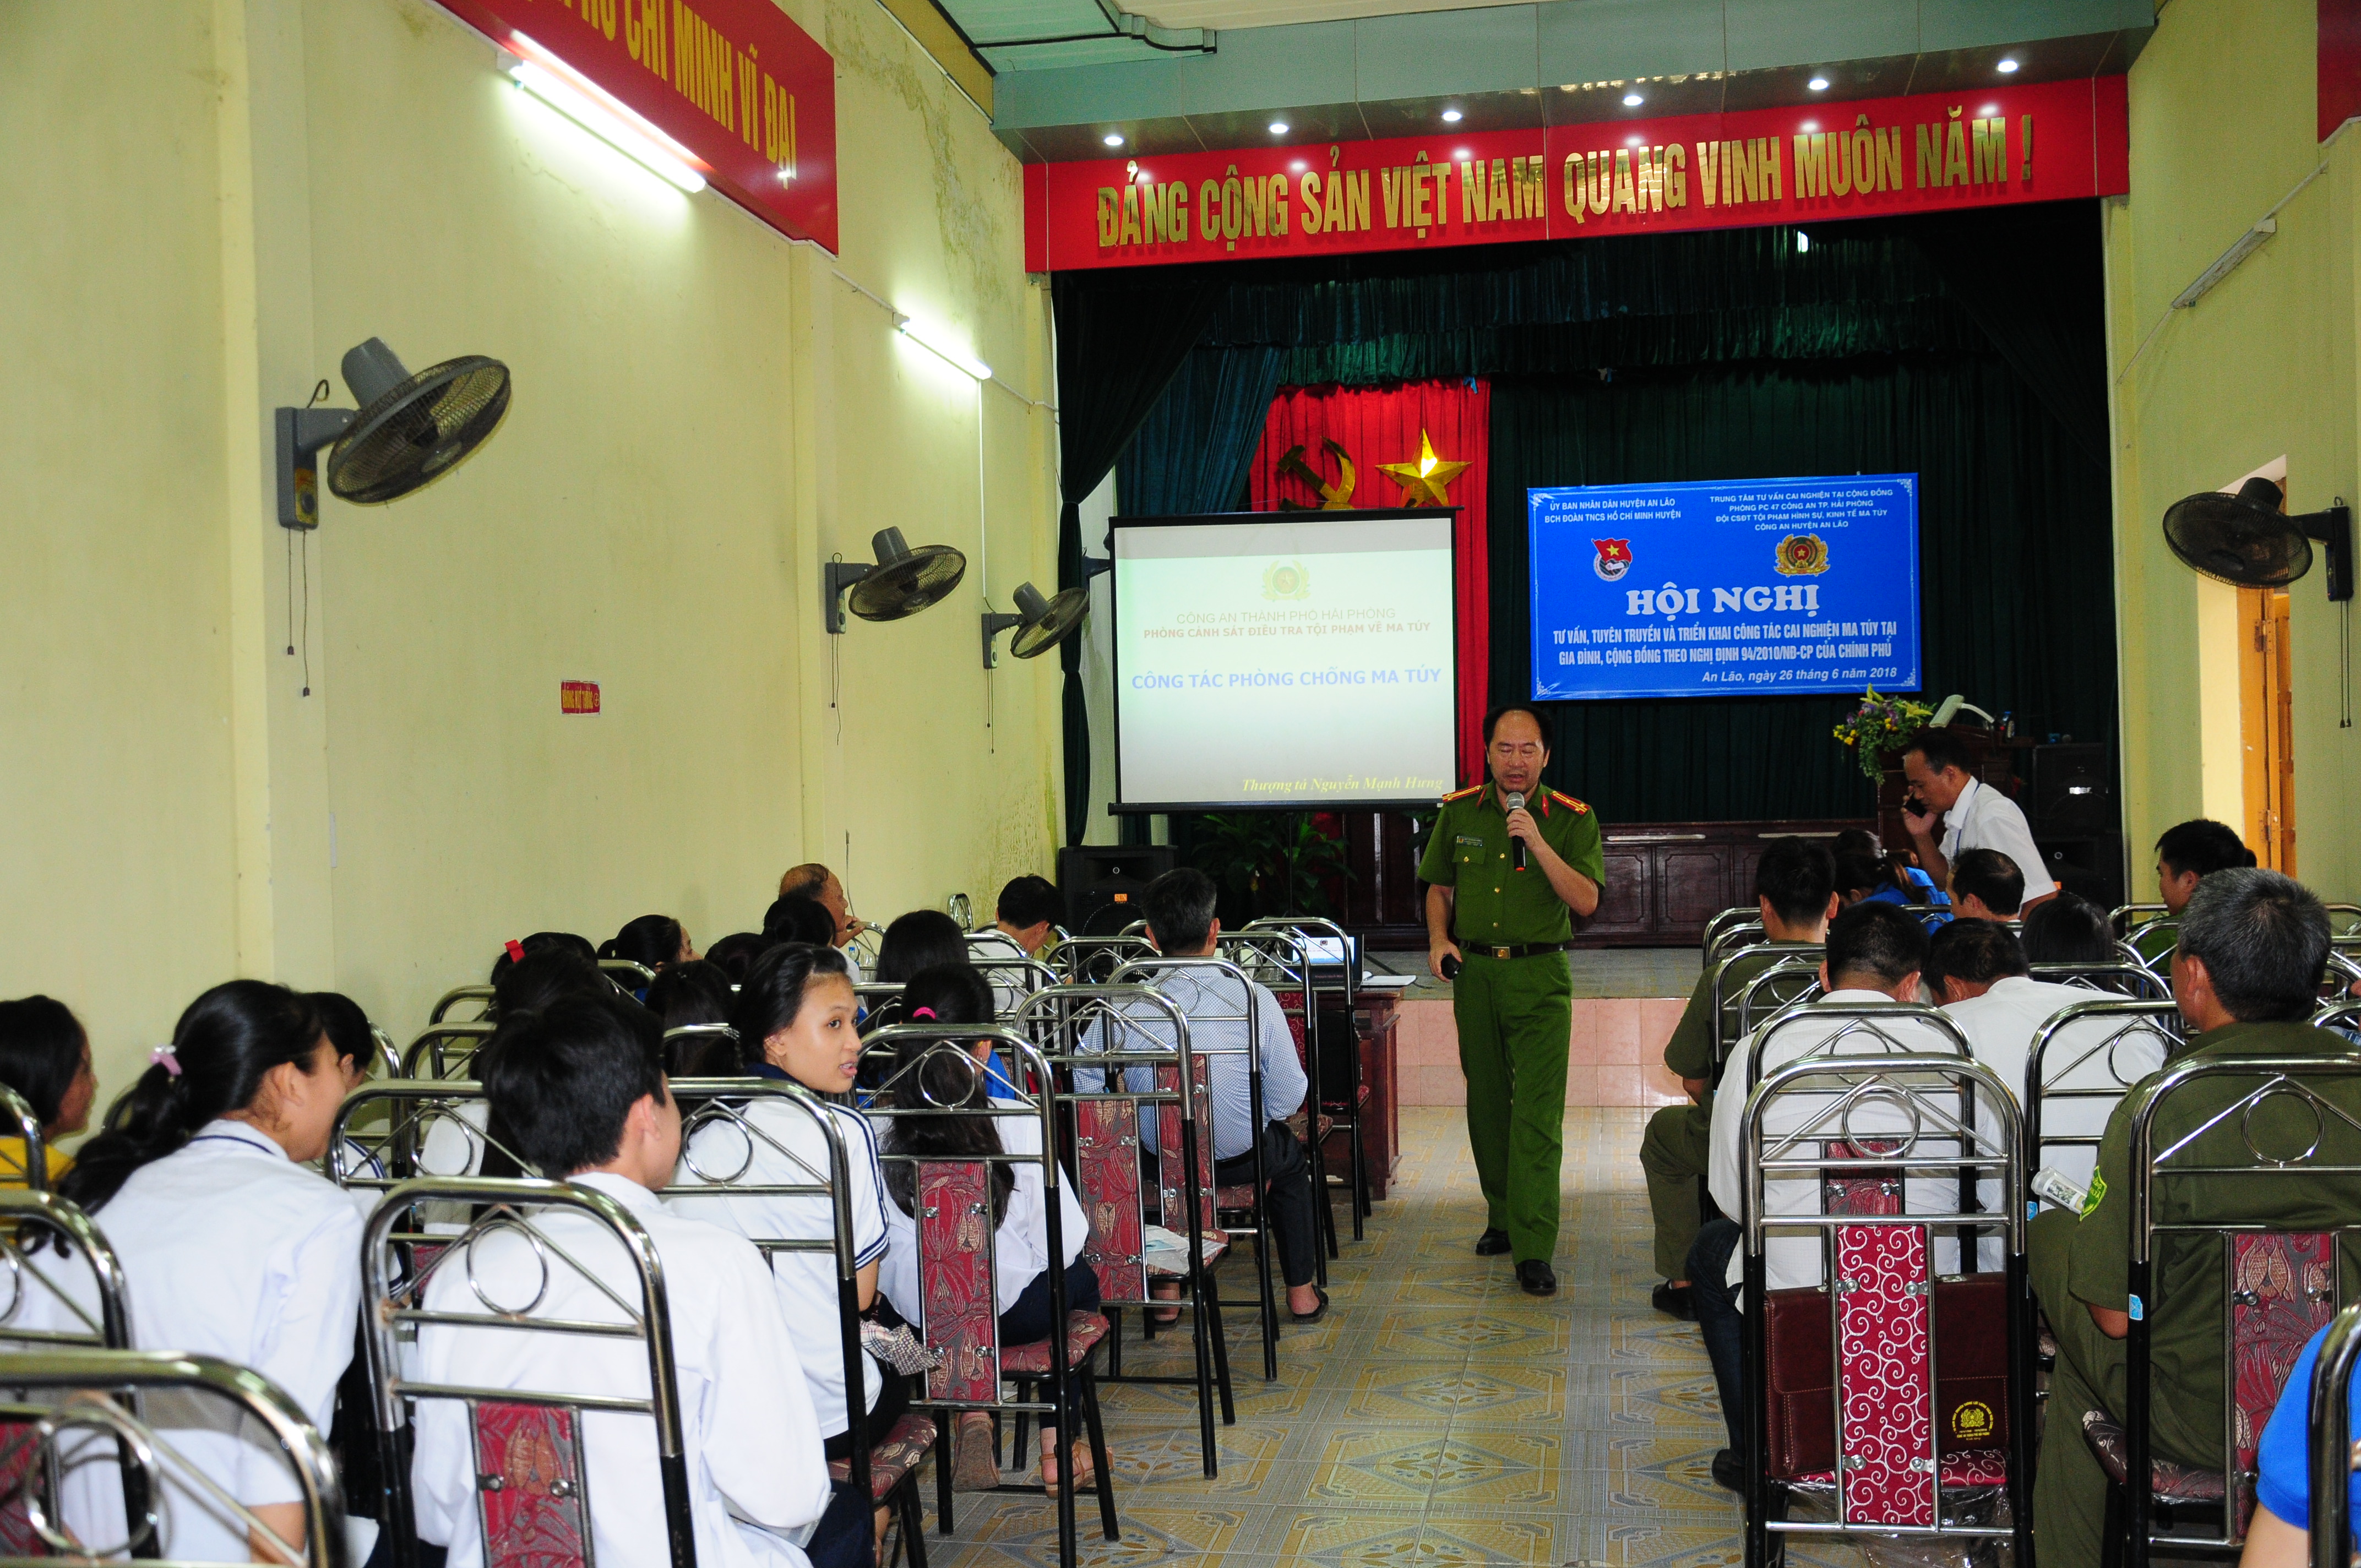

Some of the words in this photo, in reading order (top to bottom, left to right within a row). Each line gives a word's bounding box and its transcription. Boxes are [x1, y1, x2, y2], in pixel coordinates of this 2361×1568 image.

[673, 0, 733, 133] MINH
[764, 73, 797, 190] ĐẠI
[1097, 160, 1189, 248] ĐẢNG
[1200, 165, 1289, 251] CỘNG
[1301, 145, 1370, 235] SẢN
[1381, 150, 1451, 238] VIỆT
[1461, 155, 1545, 223] NAM
[1564, 143, 1686, 224] QUANG
[1696, 137, 1782, 209] VINH
[1792, 113, 1902, 200] MUÔN
[1916, 105, 2008, 190] NĂM
[1550, 500, 1560, 510] ỦY
[1562, 502, 1577, 510] BAN
[1580, 499, 1600, 510] NHÂN
[1602, 499, 1618, 509] DÂN
[1620, 498, 1645, 509] HUYỆN
[1660, 497, 1675, 507] LÃO
[1729, 504, 1756, 512] PHÒNG
[1781, 502, 1803, 510] CÔNG
[1831, 499, 1844, 508] HẢI
[1846, 499, 1874, 507] PHÒNG
[1544, 515, 1560, 523] BCH
[1563, 513, 1583, 522] ĐOÀN
[1585, 513, 1606, 521] TNCS
[1620, 510, 1633, 520] CHÍ
[1634, 511, 1653, 520] MINH
[1655, 509, 1681, 520] HUYỆN
[1755, 522, 1777, 531] CÔNG
[1792, 521, 1818, 529] HUYỆN
[1832, 520, 1849, 528] LÃO
[1626, 581, 1700, 621] HỘI
[1712, 585, 1820, 617] NGHỊ
[1177, 612, 1215, 624] CÔNG
[1219, 613, 1237, 623] AN
[1241, 610, 1286, 622] THÀNH
[1348, 606, 1395, 619] PHÒNG
[1144, 627, 1184, 639] PHÒNG
[1223, 624, 1244, 636] SÁT
[1280, 626, 1303, 635] TRA
[1306, 623, 1327, 636] TỘI
[1331, 624, 1364, 635] PHẠM
[1386, 623, 1403, 632] MA
[1407, 619, 1430, 631] TÚY
[1553, 629, 1566, 644] TƯ
[1568, 625, 1590, 645] VẤN,
[1592, 627, 1622, 644] TUYÊN
[1663, 625, 1676, 641] VÀ
[1678, 622, 1706, 641] TRIỂN
[1708, 625, 1731, 640] KHAI
[1734, 623, 1760, 640] CÔNG
[1762, 622, 1781, 639] TÁC
[1784, 624, 1800, 639] CAI
[1803, 620, 1839, 640] NGHIỆN
[1842, 623, 1858, 636] MA
[1860, 619, 1878, 636] TÚY
[1881, 622, 1897, 639] TẠI
[1559, 651, 1575, 665] GIA
[1577, 648, 1603, 666] ĐÌNH,
[1606, 647, 1631, 667] CỘNG
[1634, 645, 1661, 663] ĐỒNG
[1663, 648, 1687, 662] THEO
[1689, 648, 1713, 665] NGHỊ
[1715, 646, 1739, 664] ĐỊNH
[1816, 640, 1836, 658] CỦA
[1838, 641, 1869, 658] CHÍNH
[1871, 638, 1892, 657] PHỦ
[1132, 671, 1183, 689] CÔNG
[1189, 669, 1223, 688] TÁC
[1229, 668, 1294, 687] PHÒNG
[1300, 666, 1366, 685] CHỐNG
[1372, 670, 1399, 684] MA
[1405, 665, 1441, 683] TÚY
[1702, 672, 1718, 682] An
[1721, 671, 1745, 683] Lão,
[1748, 670, 1776, 683] ngày
[1779, 670, 1793, 680] 26
[1796, 668, 1829, 681] tháng
[1832, 668, 1840, 678] 6
[1842, 668, 1867, 678] năm
[1869, 667, 1897, 678] 2018
[1242, 778, 1292, 793] Thượng
[1310, 775, 1359, 792] Nguyễn
[1362, 777, 1400, 792] Mạnh
